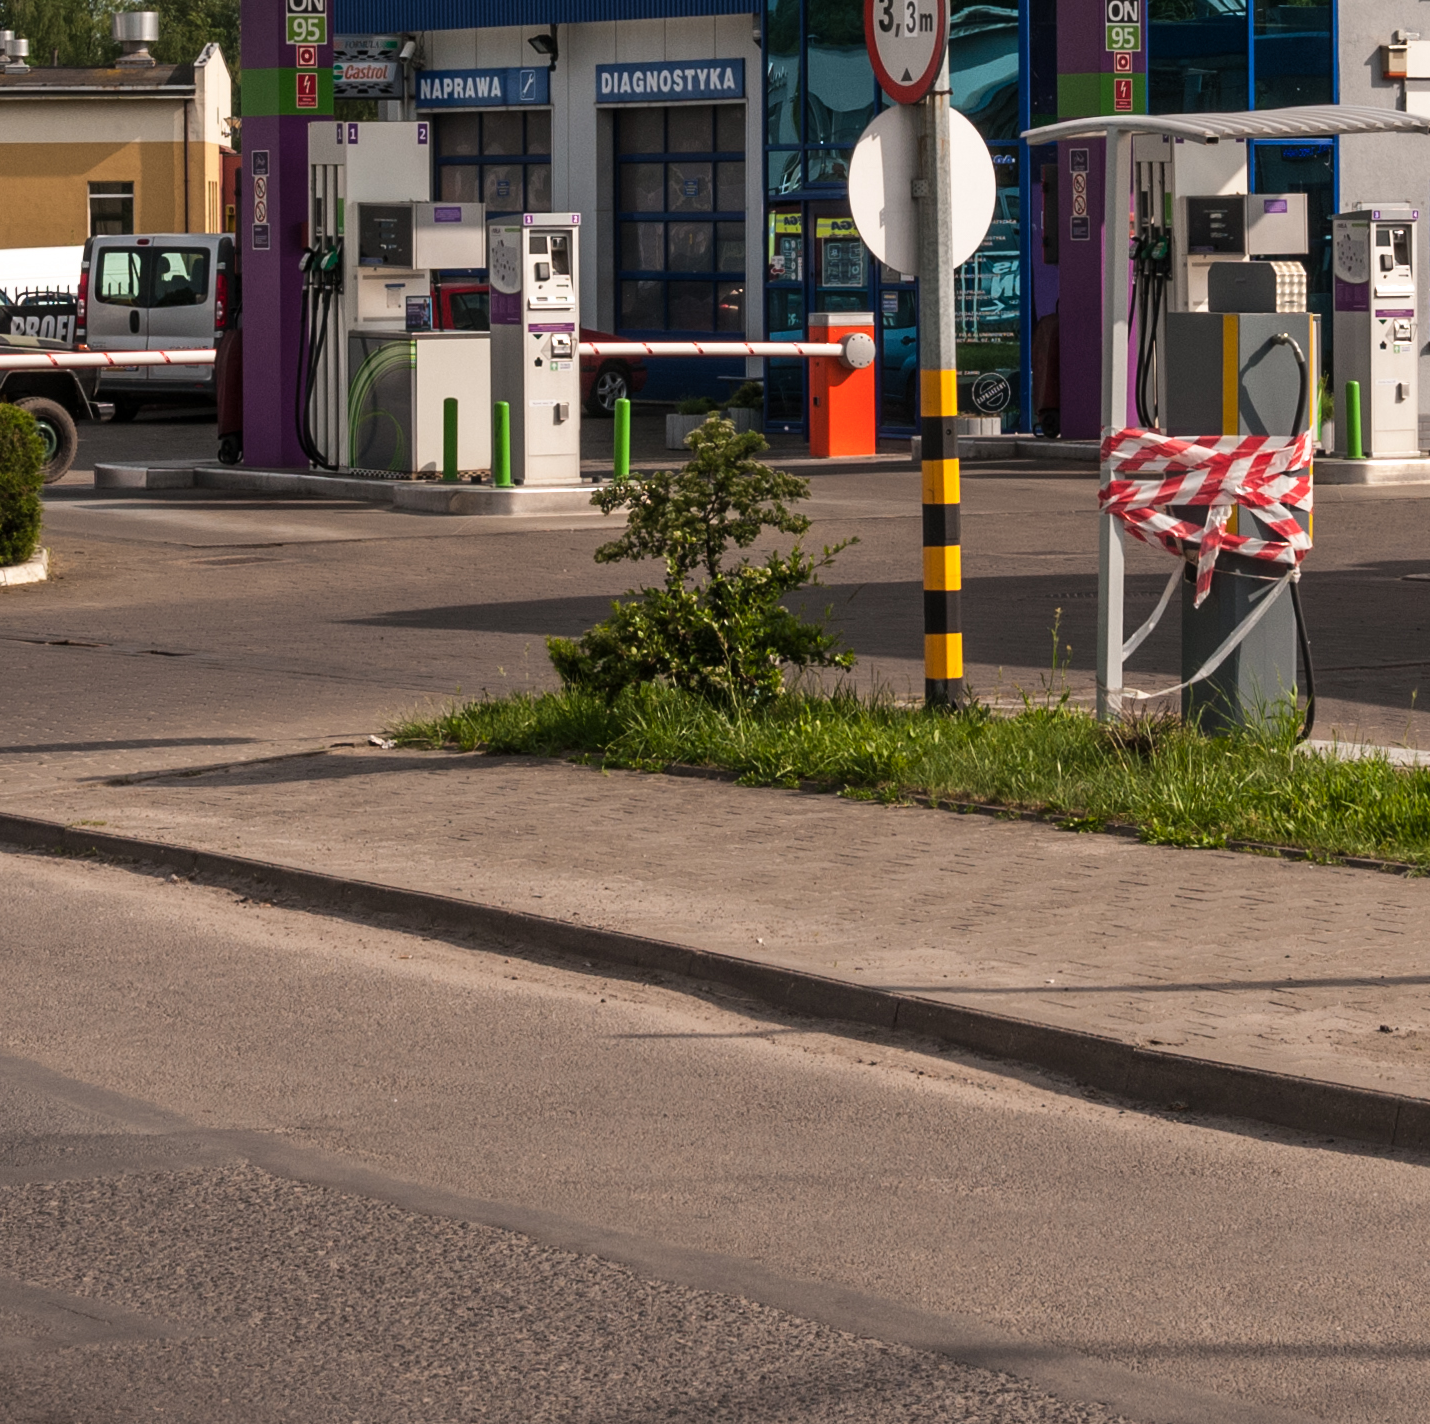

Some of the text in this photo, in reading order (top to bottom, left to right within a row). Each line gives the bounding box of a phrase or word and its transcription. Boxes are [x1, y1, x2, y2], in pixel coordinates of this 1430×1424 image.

[1108, 0, 1138, 22] ON
[293, 18, 320, 41] 95
[1111, 27, 1135, 48] 95
[344, 64, 388, 80] Castrol
[601, 67, 735, 94] DIAGNOSTYKA
[421, 76, 501, 99] NAPRAWA
